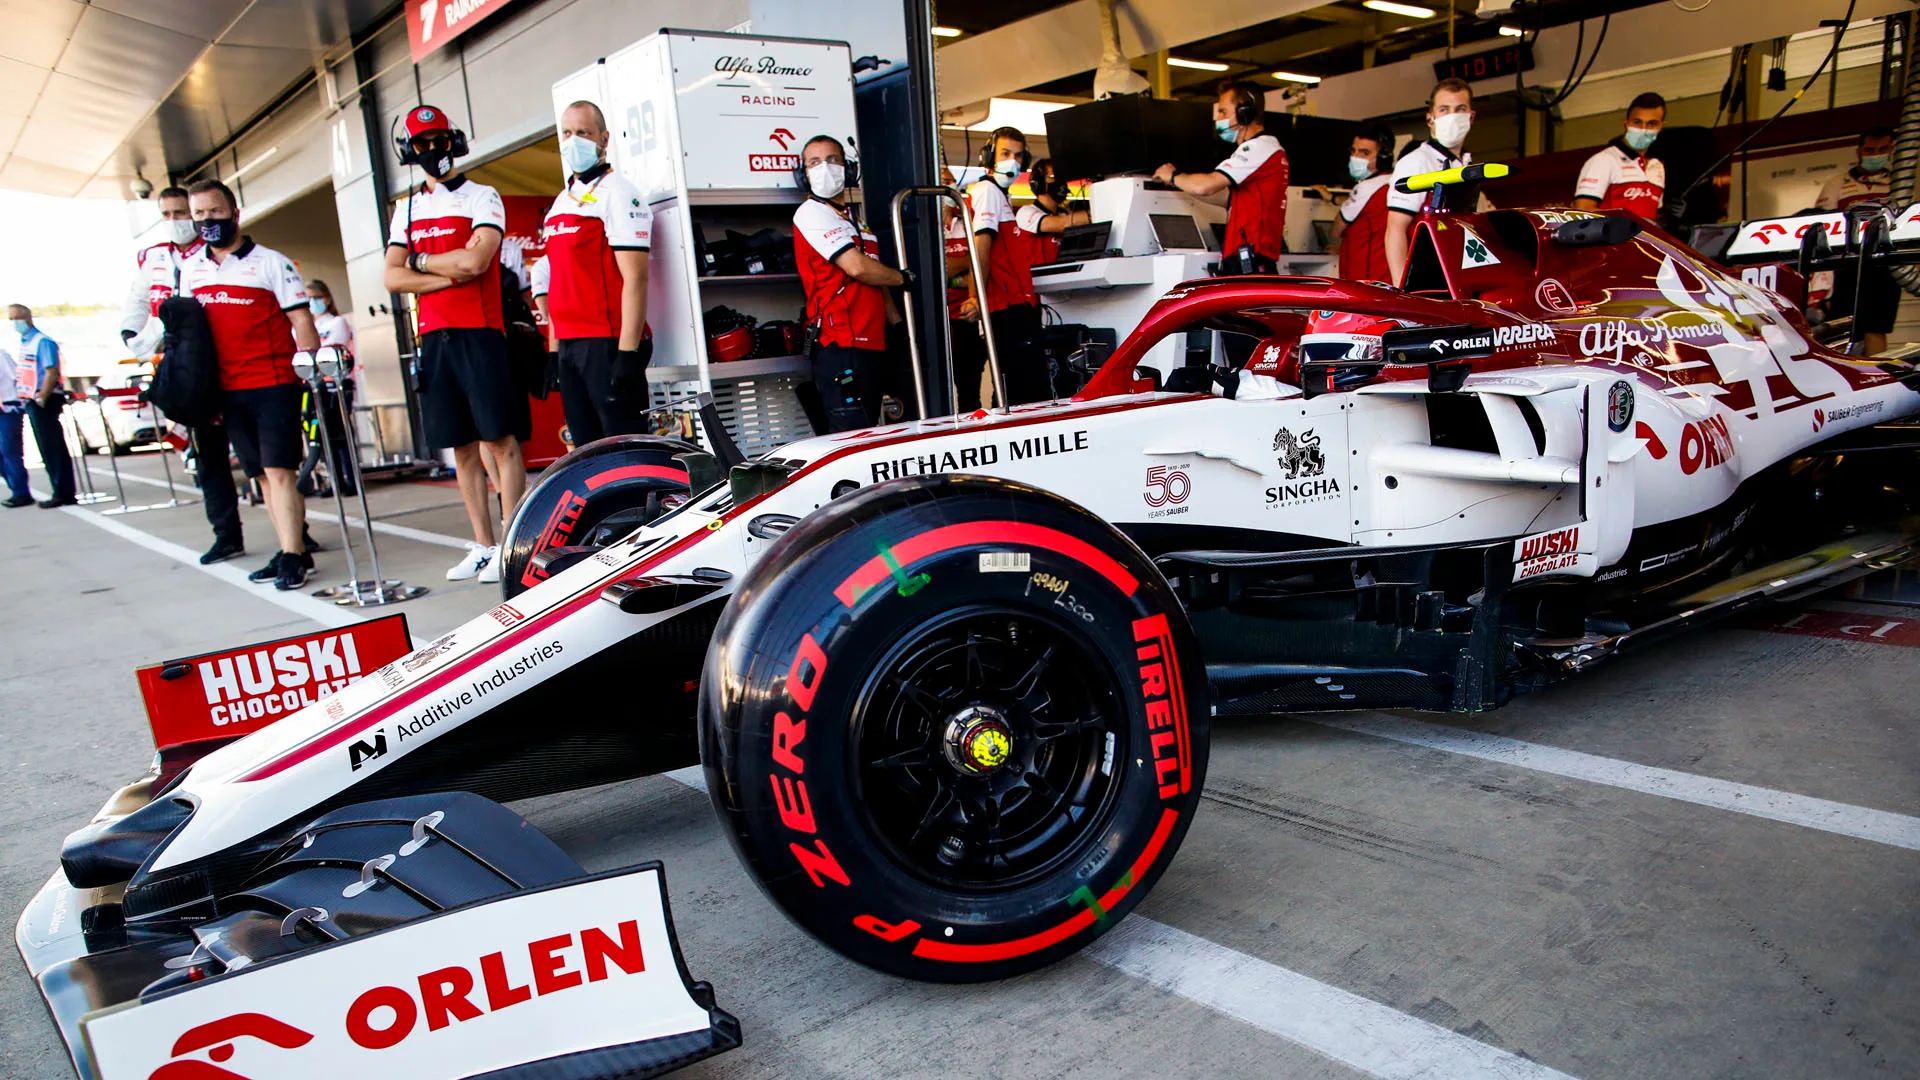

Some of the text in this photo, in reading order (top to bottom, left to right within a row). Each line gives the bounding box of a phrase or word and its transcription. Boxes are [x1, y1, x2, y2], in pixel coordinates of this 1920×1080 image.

[420, 0, 438, 44] 7
[715, 56, 813, 79] Alfa Romeo
[742, 95, 795, 106] RACING
[751, 156, 798, 169] ORLEN
[1453, 337, 1490, 350] ORLEN
[1580, 319, 1723, 367] Alfa Romeo
[1828, 408, 1849, 422] SAUBER
[871, 430, 1088, 484] RICHARD MILLE
[1143, 465, 1191, 508] 50
[1265, 478, 1340, 504] SINGHA
[1265, 494, 1341, 510] CORPORATION
[1148, 506, 1189, 519] YEARS SAUBER
[1520, 527, 1579, 567] HUSKI
[1520, 554, 1578, 579] CHOCOLATE
[198, 632, 362, 704] HUSKI
[397, 638, 563, 742] Additive Industries
[1131, 613, 1191, 800] PIRELLI
[770, 632, 921, 942] P ZERO
[345, 919, 646, 1050] ORLEN
